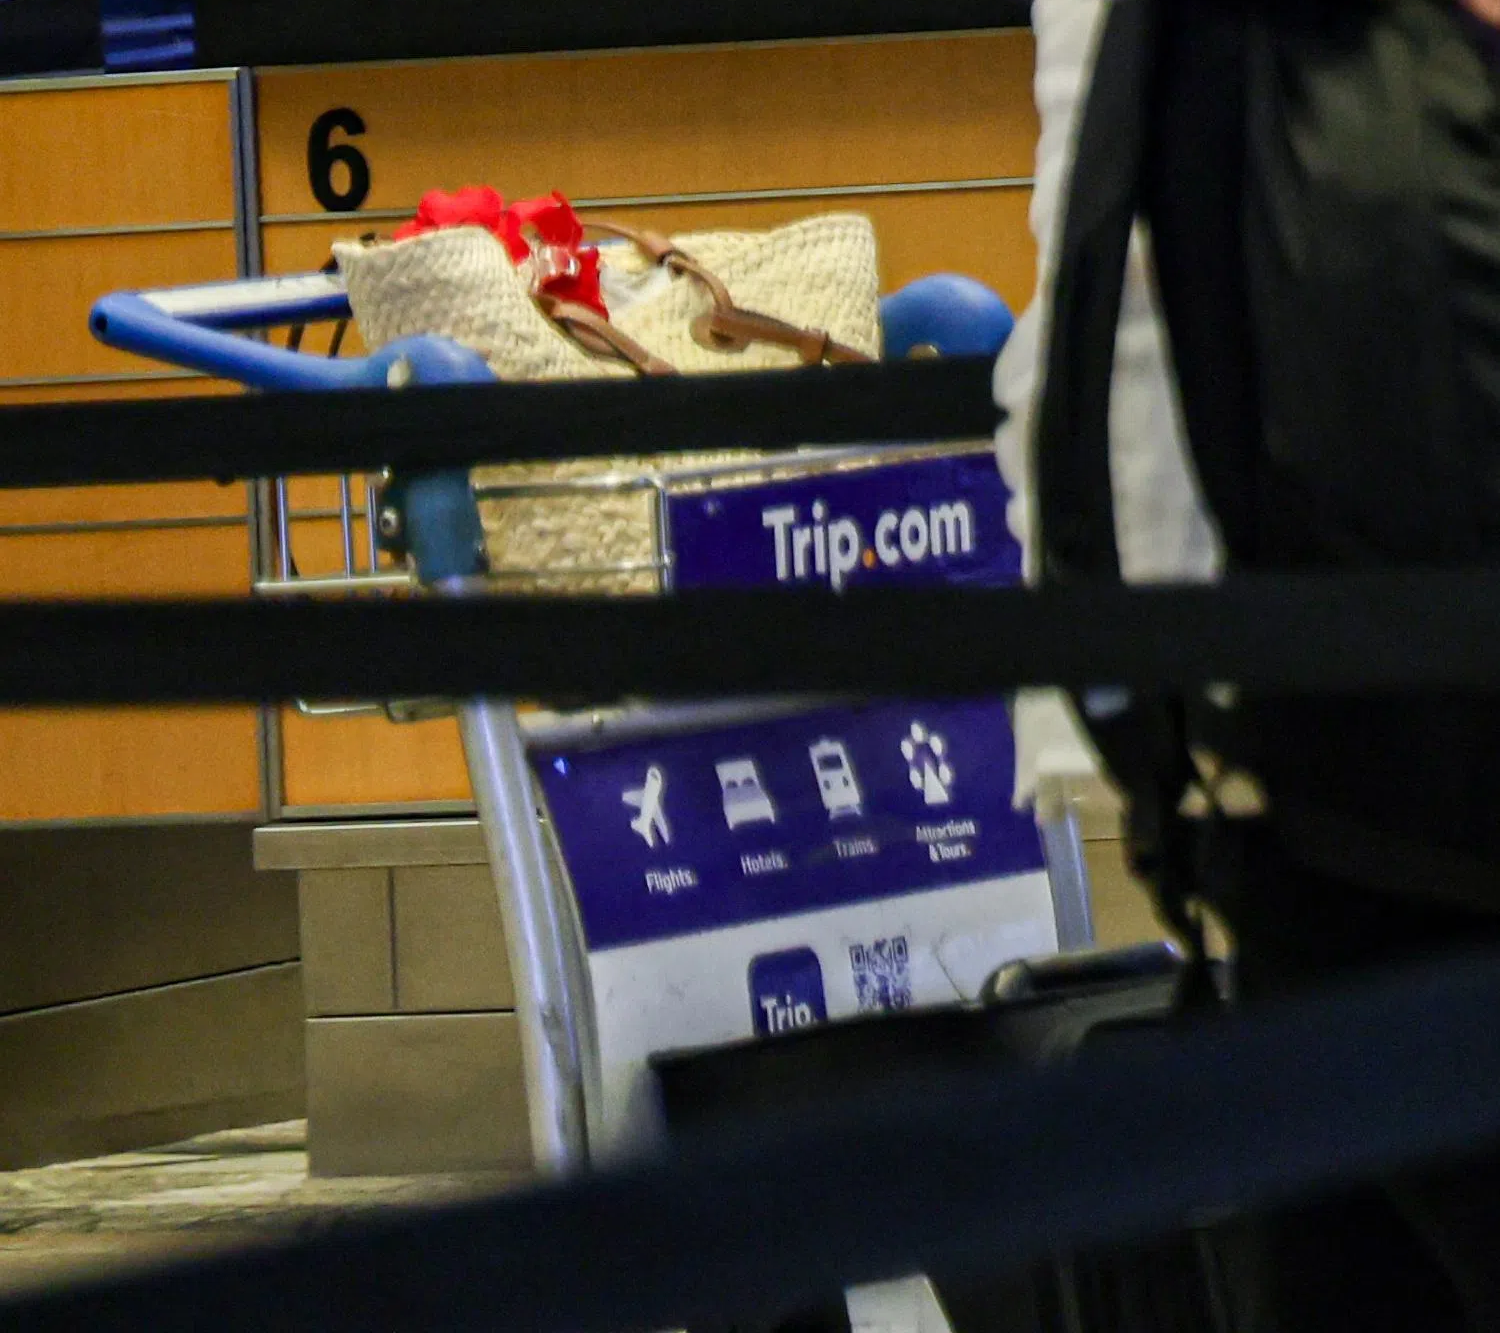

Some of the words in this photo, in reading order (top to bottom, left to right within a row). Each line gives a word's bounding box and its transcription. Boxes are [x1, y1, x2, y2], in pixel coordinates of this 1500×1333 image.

[306, 107, 371, 213] 6
[762, 498, 976, 590] Trip.com
[915, 818, 977, 843] Attractions
[740, 850, 789, 876] Hotels.
[645, 867, 697, 895] Flights.
